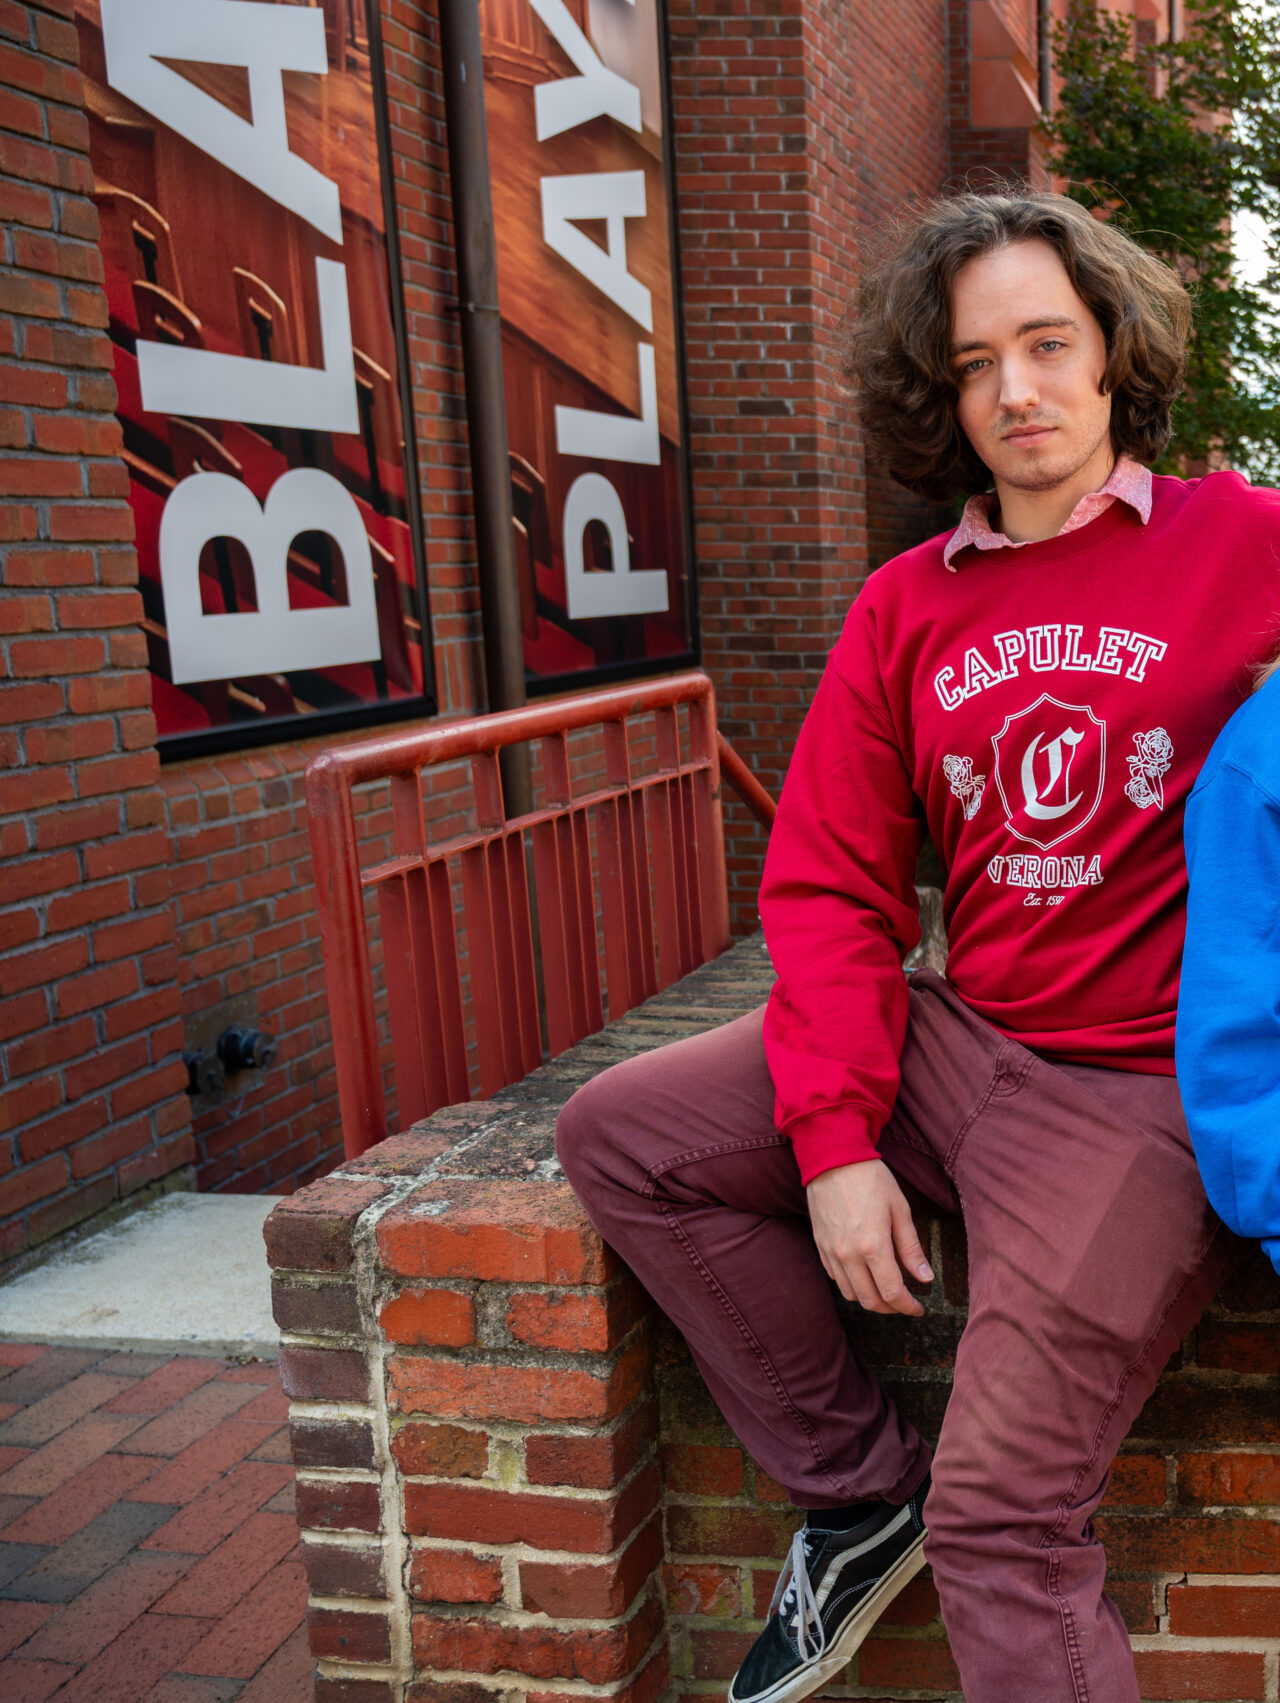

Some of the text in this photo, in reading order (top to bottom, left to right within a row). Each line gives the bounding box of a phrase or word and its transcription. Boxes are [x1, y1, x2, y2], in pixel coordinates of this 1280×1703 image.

[528, 0, 669, 620] PLAY
[934, 623, 1168, 711] CAPULET
[1021, 726, 1085, 820] C
[987, 853, 1104, 889] VERONA
[1045, 895, 1066, 907] 1597
